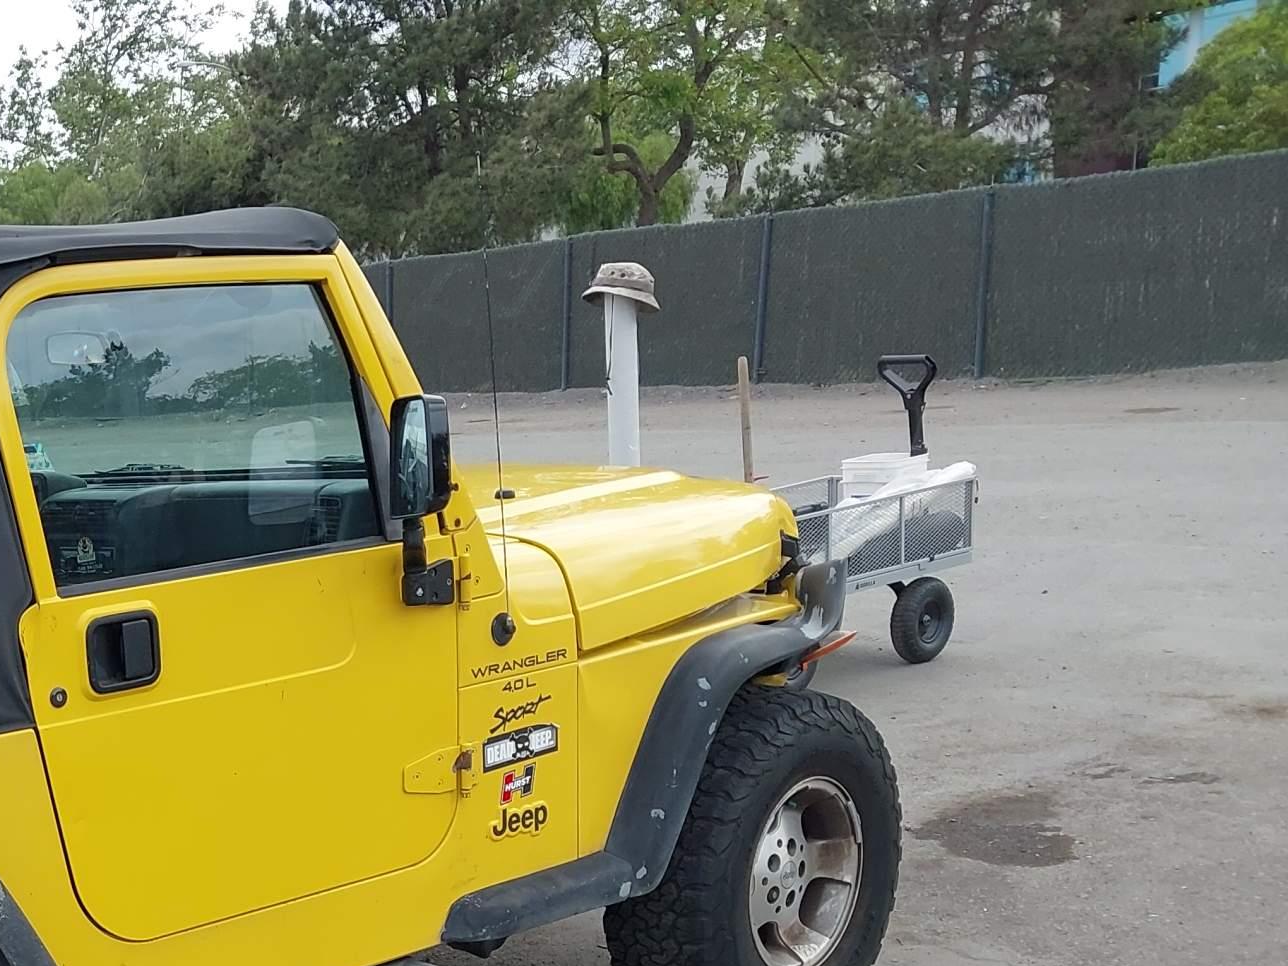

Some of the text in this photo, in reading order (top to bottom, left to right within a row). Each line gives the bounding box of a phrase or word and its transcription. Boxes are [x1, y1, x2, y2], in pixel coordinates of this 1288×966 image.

[471, 649, 567, 678] WRANGLER
[489, 693, 553, 735] Sport
[504, 775, 532, 793] HURST
[492, 804, 547, 836] Jeep
